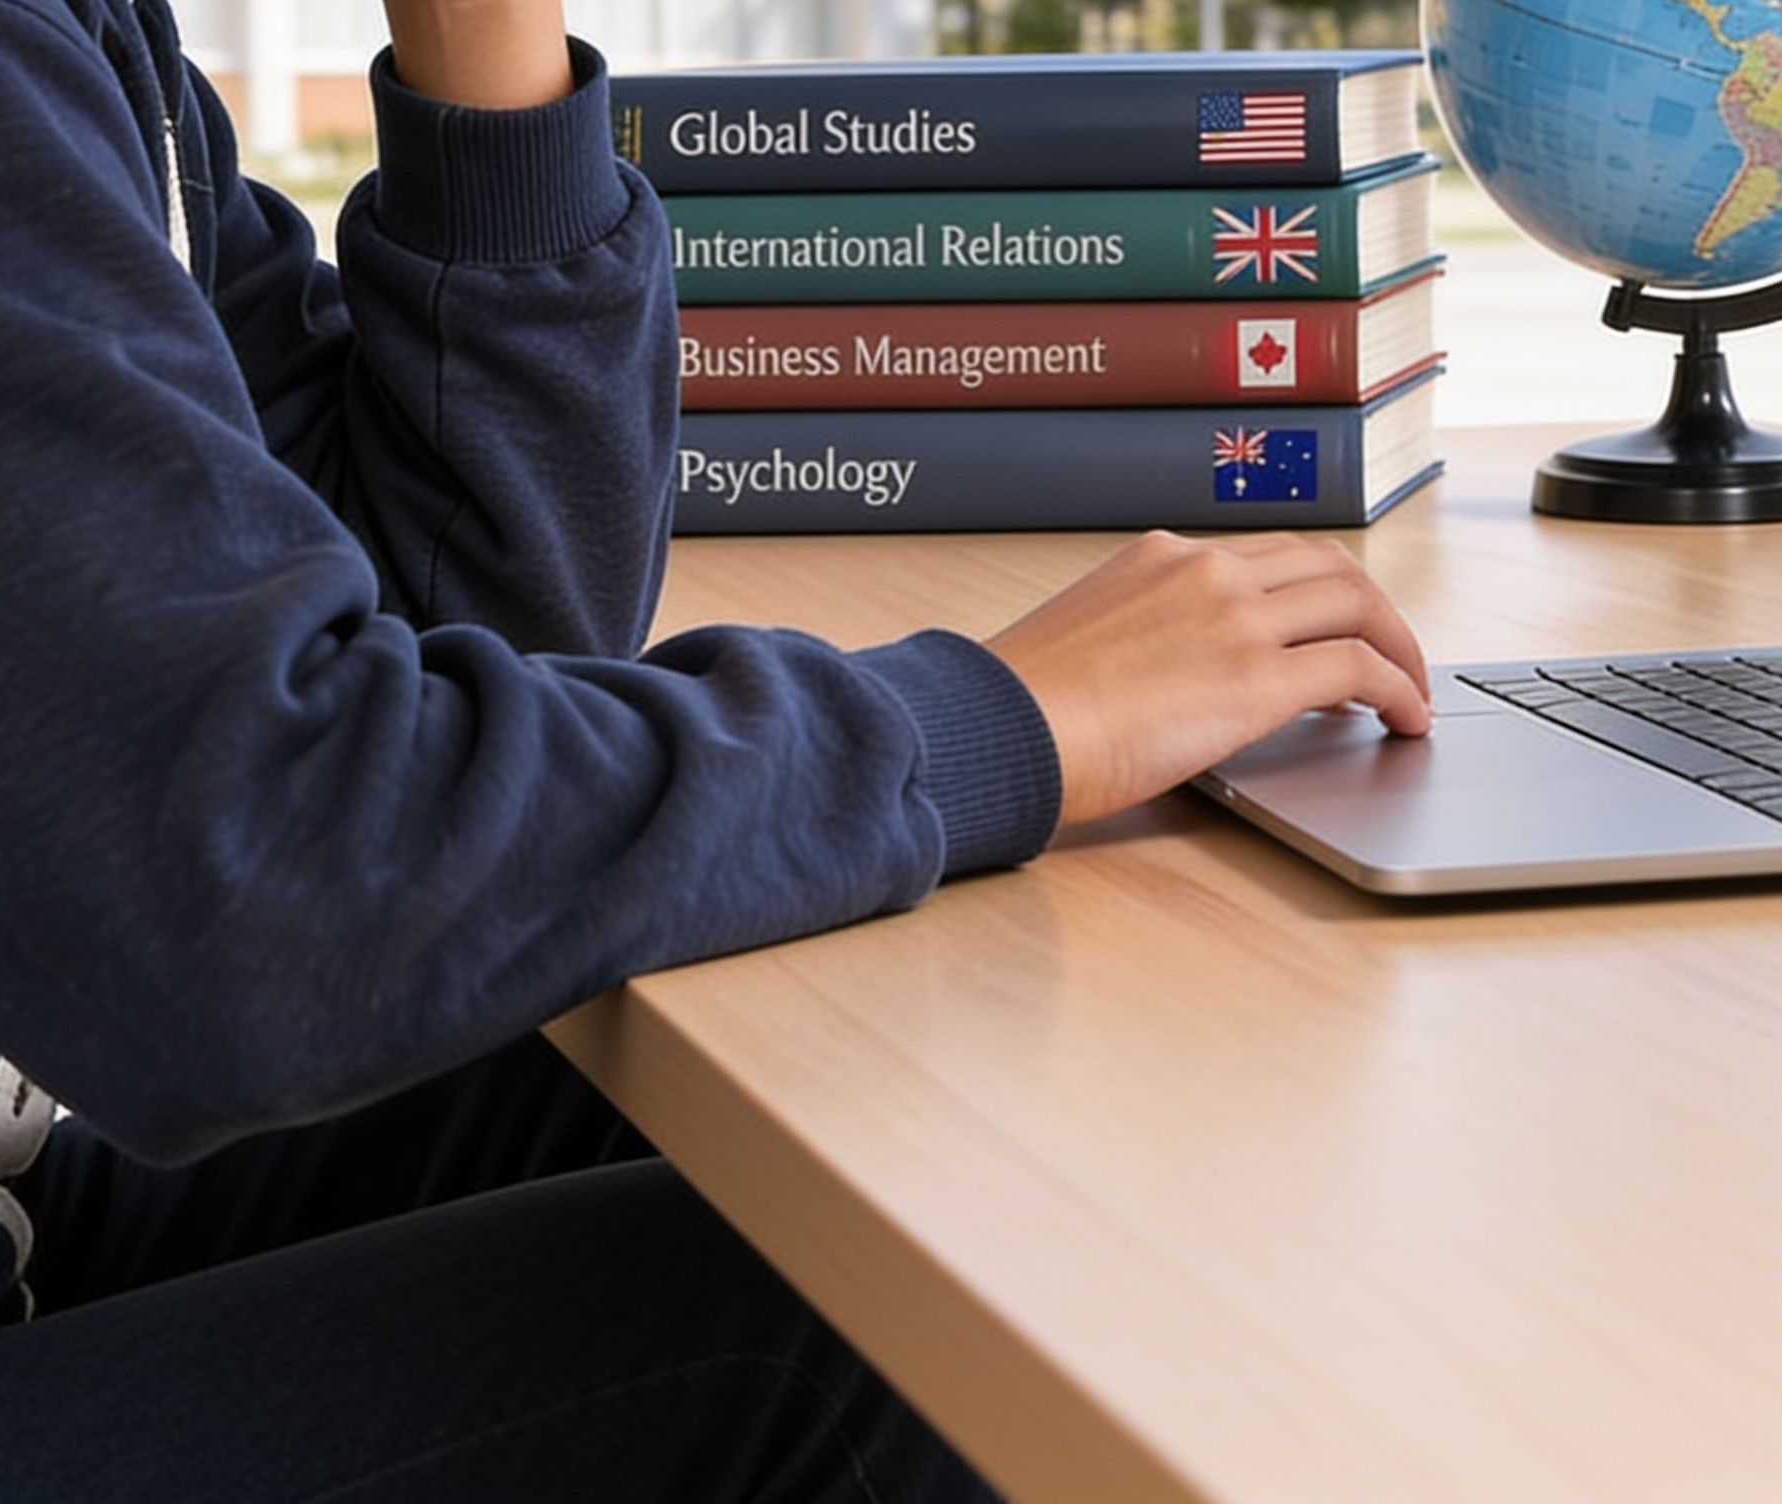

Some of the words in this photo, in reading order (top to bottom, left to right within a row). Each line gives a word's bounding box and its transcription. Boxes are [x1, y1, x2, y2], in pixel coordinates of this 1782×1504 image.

[669, 108, 810, 157] Global
[823, 107, 977, 155] Studies
[673, 222, 926, 269] International
[941, 220, 1125, 267] Relations
[678, 334, 840, 378] Business
[853, 334, 1107, 388] Management
[678, 445, 918, 507] Psychology
